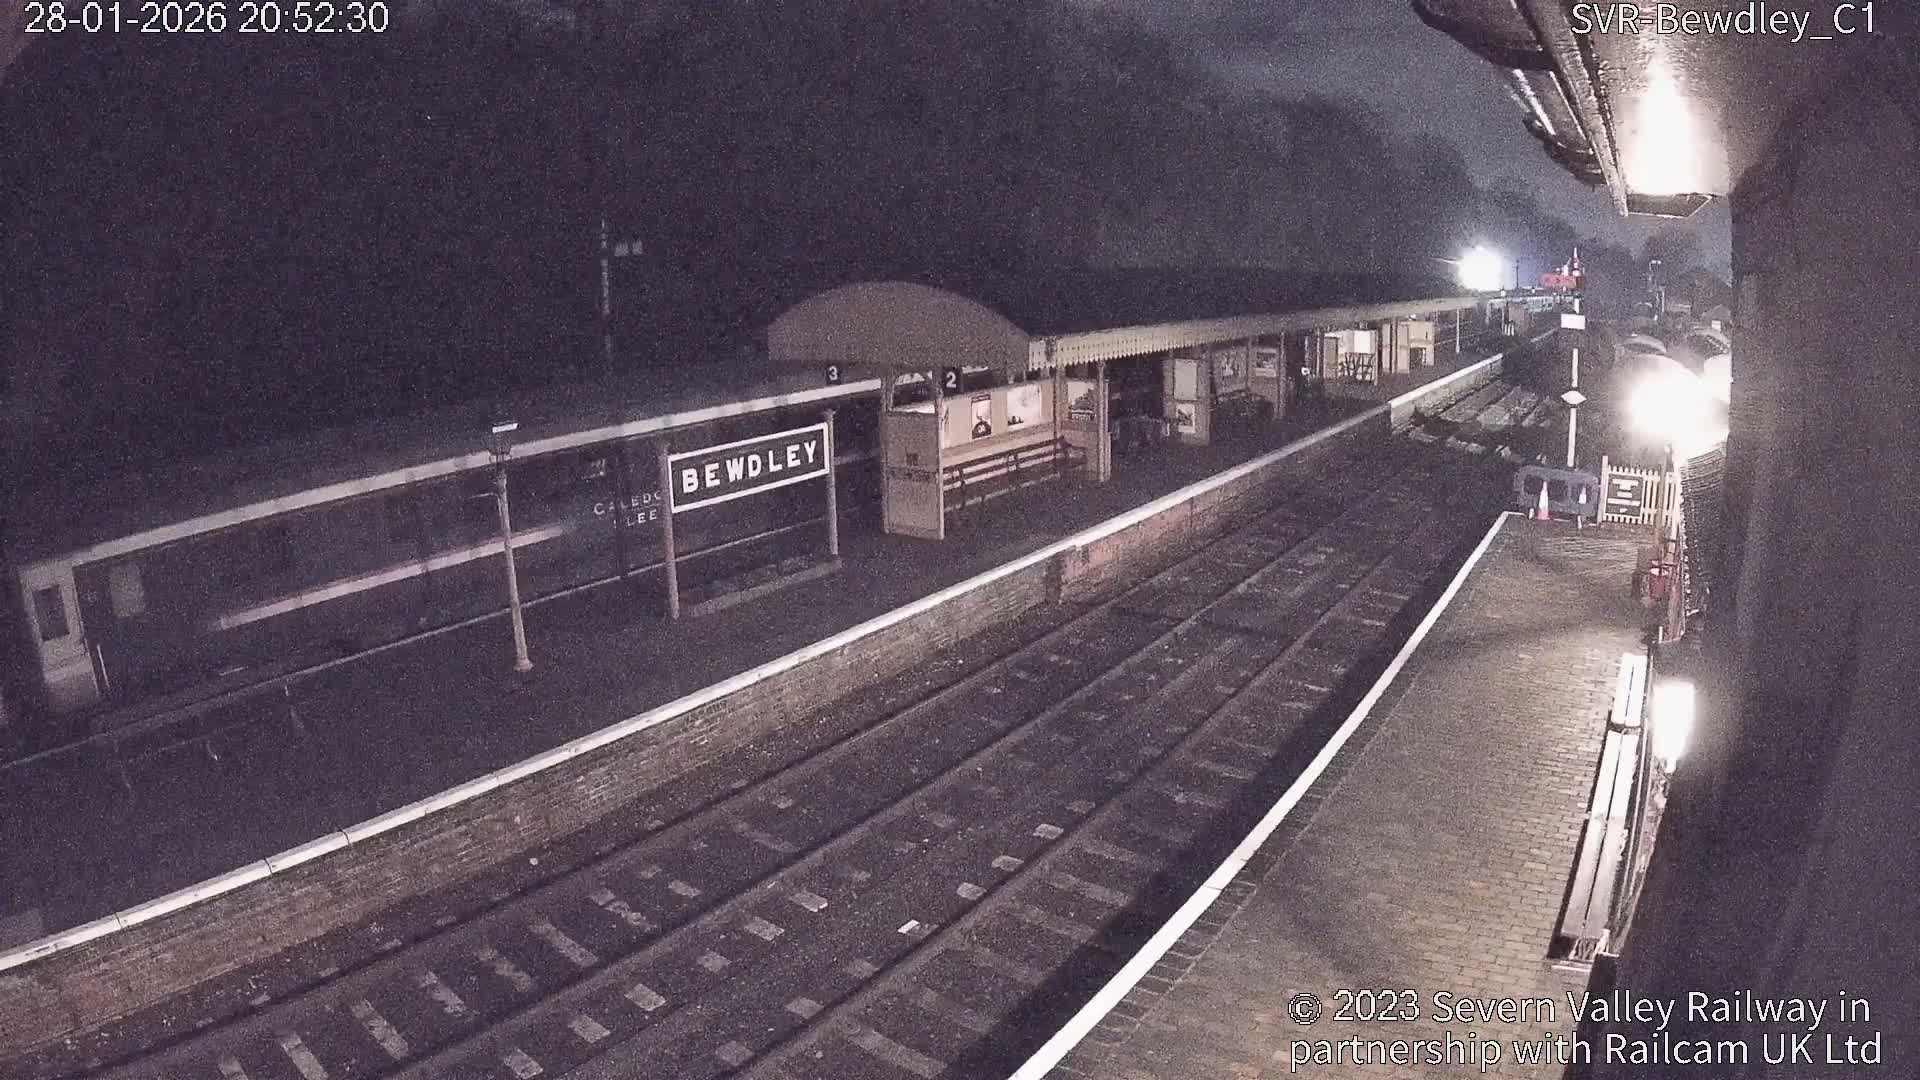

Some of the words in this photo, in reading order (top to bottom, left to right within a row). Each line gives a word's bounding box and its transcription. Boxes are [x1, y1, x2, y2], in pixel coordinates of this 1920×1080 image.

[828, 365, 839, 381] 3
[945, 371, 957, 388] 2
[681, 440, 818, 494] BEWDLEY
